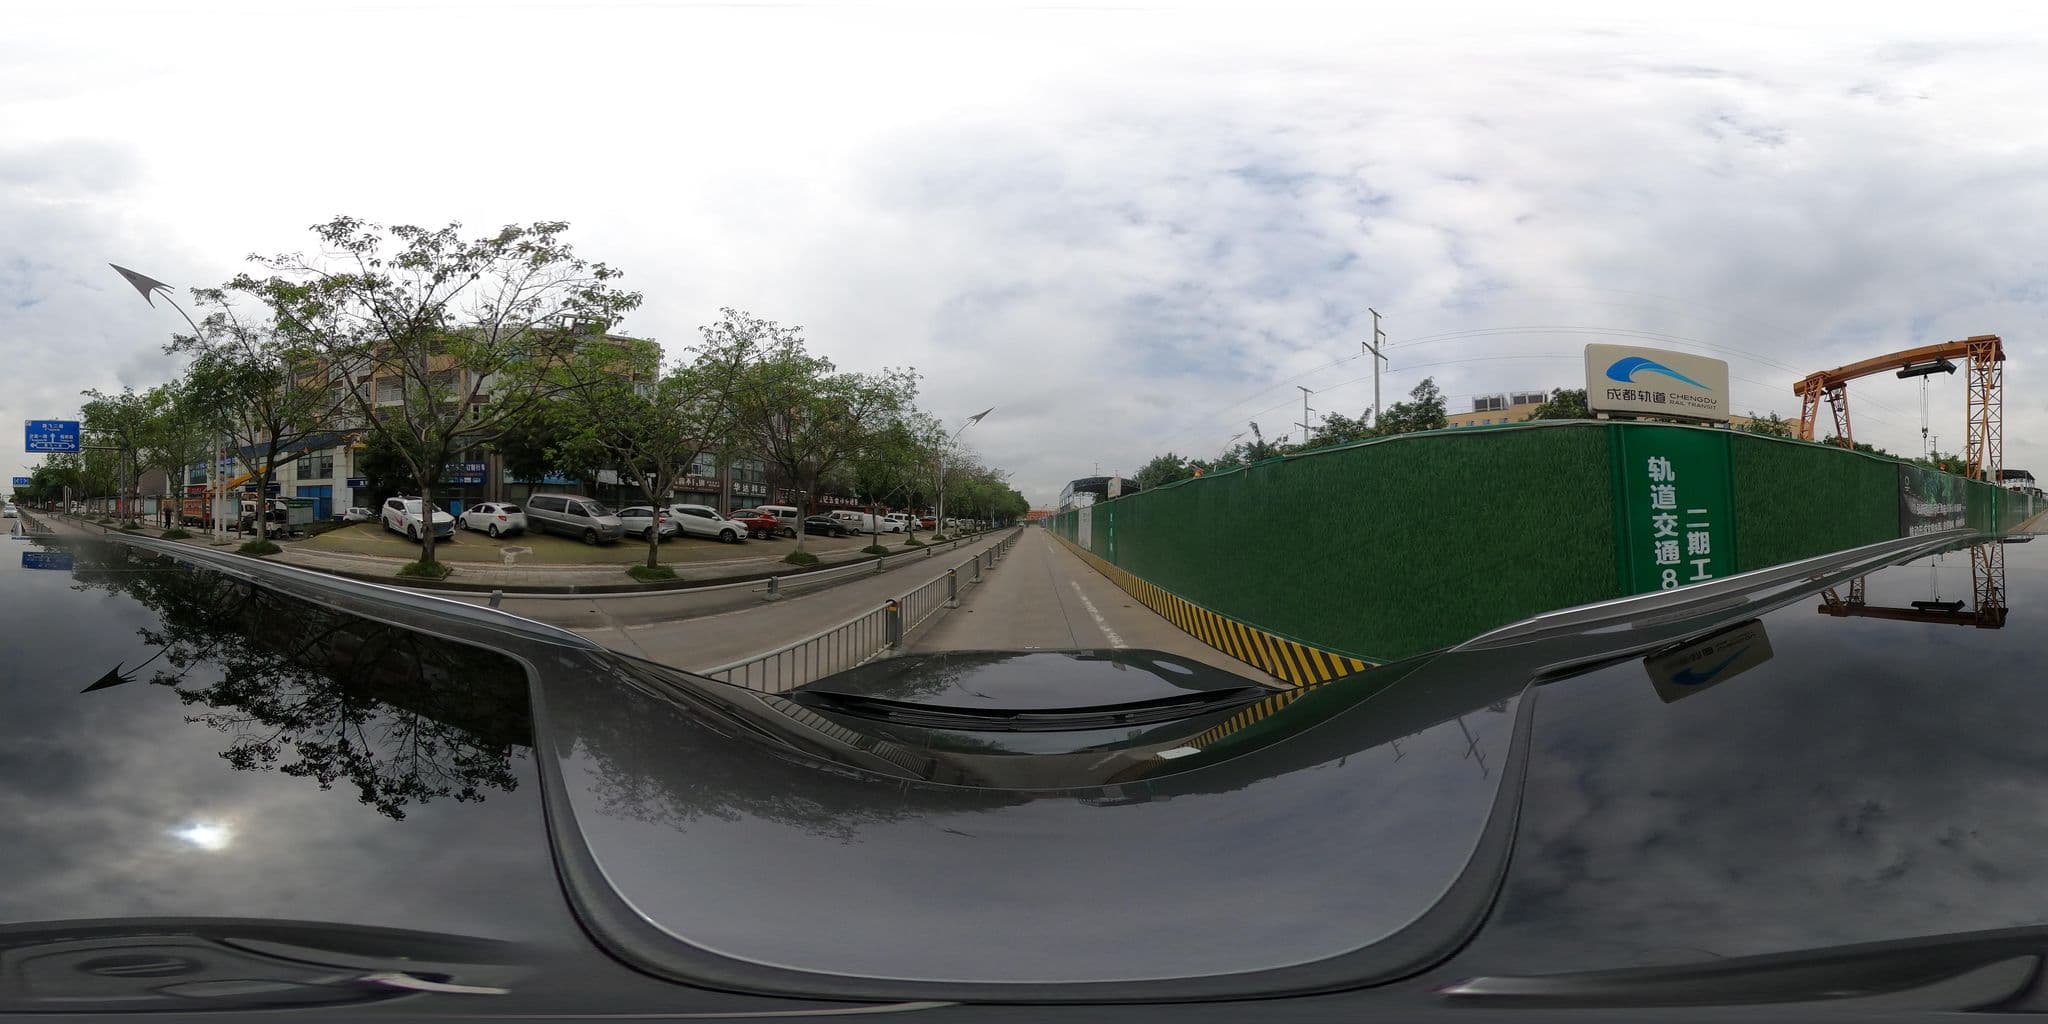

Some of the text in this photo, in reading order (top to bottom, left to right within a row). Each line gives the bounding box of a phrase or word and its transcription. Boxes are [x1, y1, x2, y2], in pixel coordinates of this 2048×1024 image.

[1606, 388, 1666, 404] 成都轨道
[1669, 393, 1717, 405] CHENGDU
[1688, 401, 1717, 410] TRANSIT
[1648, 456, 1681, 590] 轨道交通8
[1686, 508, 1712, 580] 二期工
